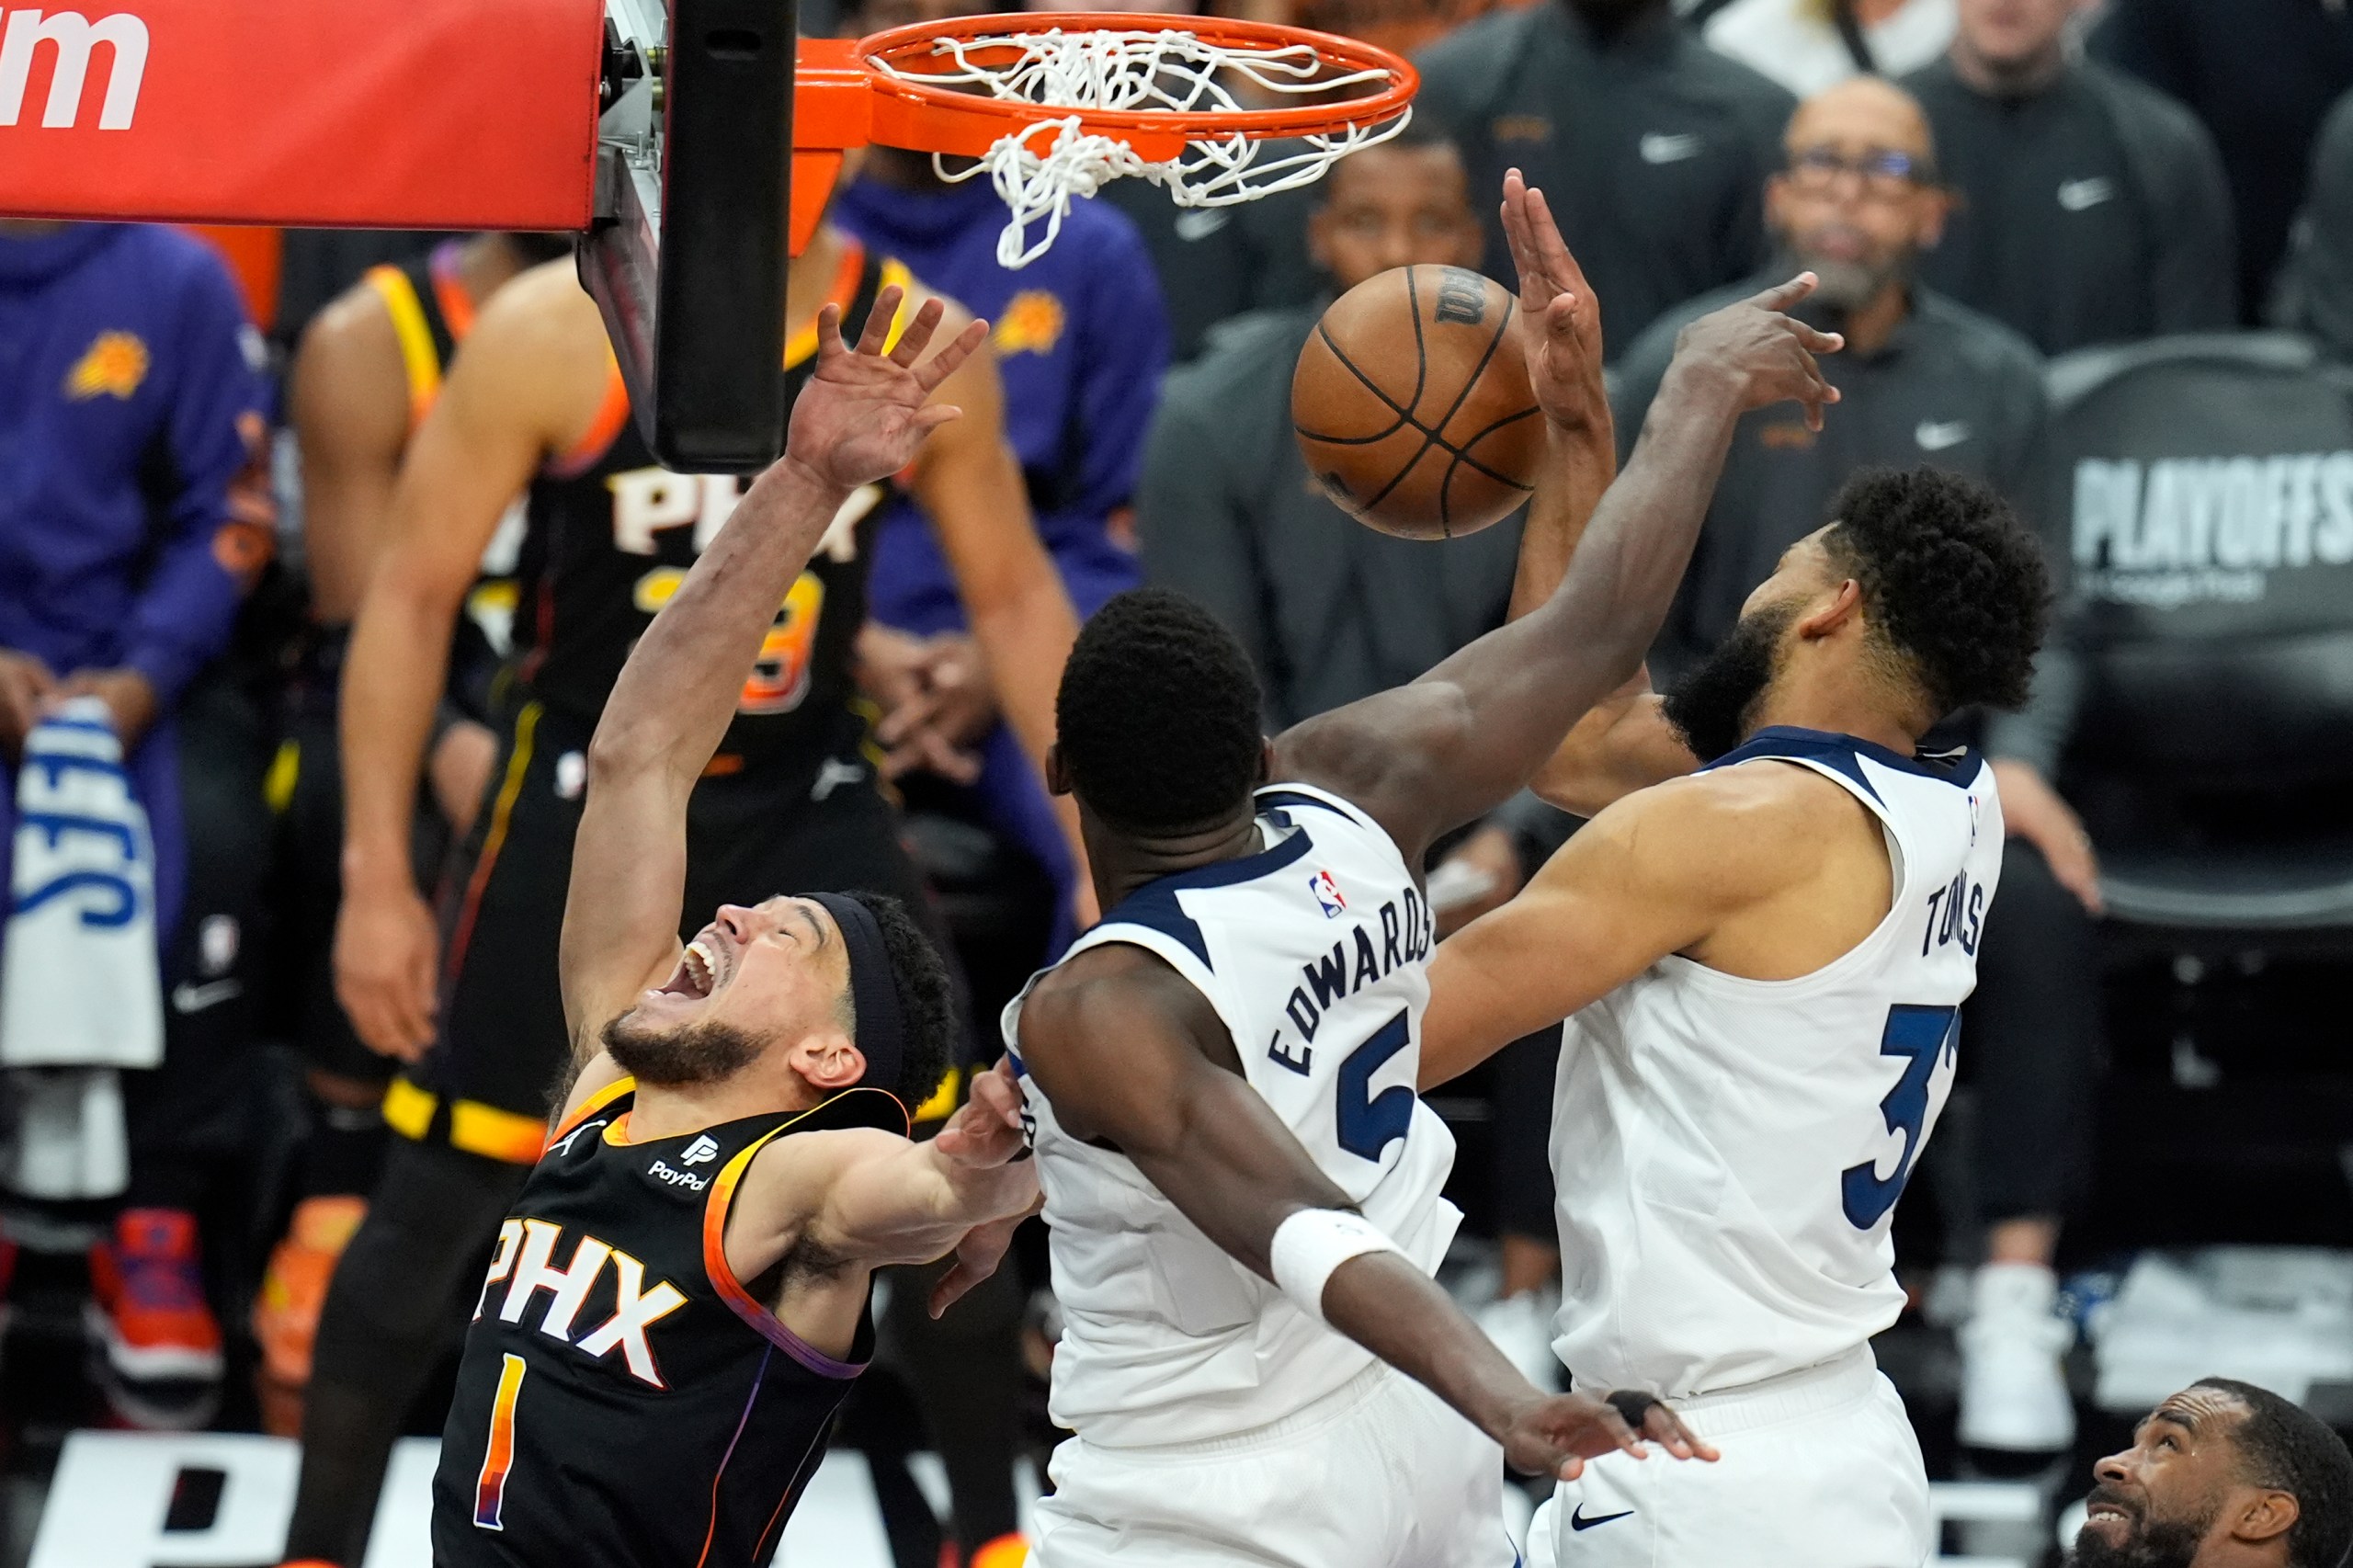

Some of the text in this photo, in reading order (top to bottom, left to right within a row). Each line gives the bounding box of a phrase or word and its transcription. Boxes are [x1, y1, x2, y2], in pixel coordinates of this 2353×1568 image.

[0, 7, 150, 131] m
[2072, 452, 2353, 568] PLAYOFFS
[1267, 887, 1431, 1077] EDWARDS
[1336, 1005, 1416, 1169] 5
[1841, 1003, 1962, 1231] 3
[471, 1217, 689, 1392] PHX
[473, 1352, 528, 1532] 1
